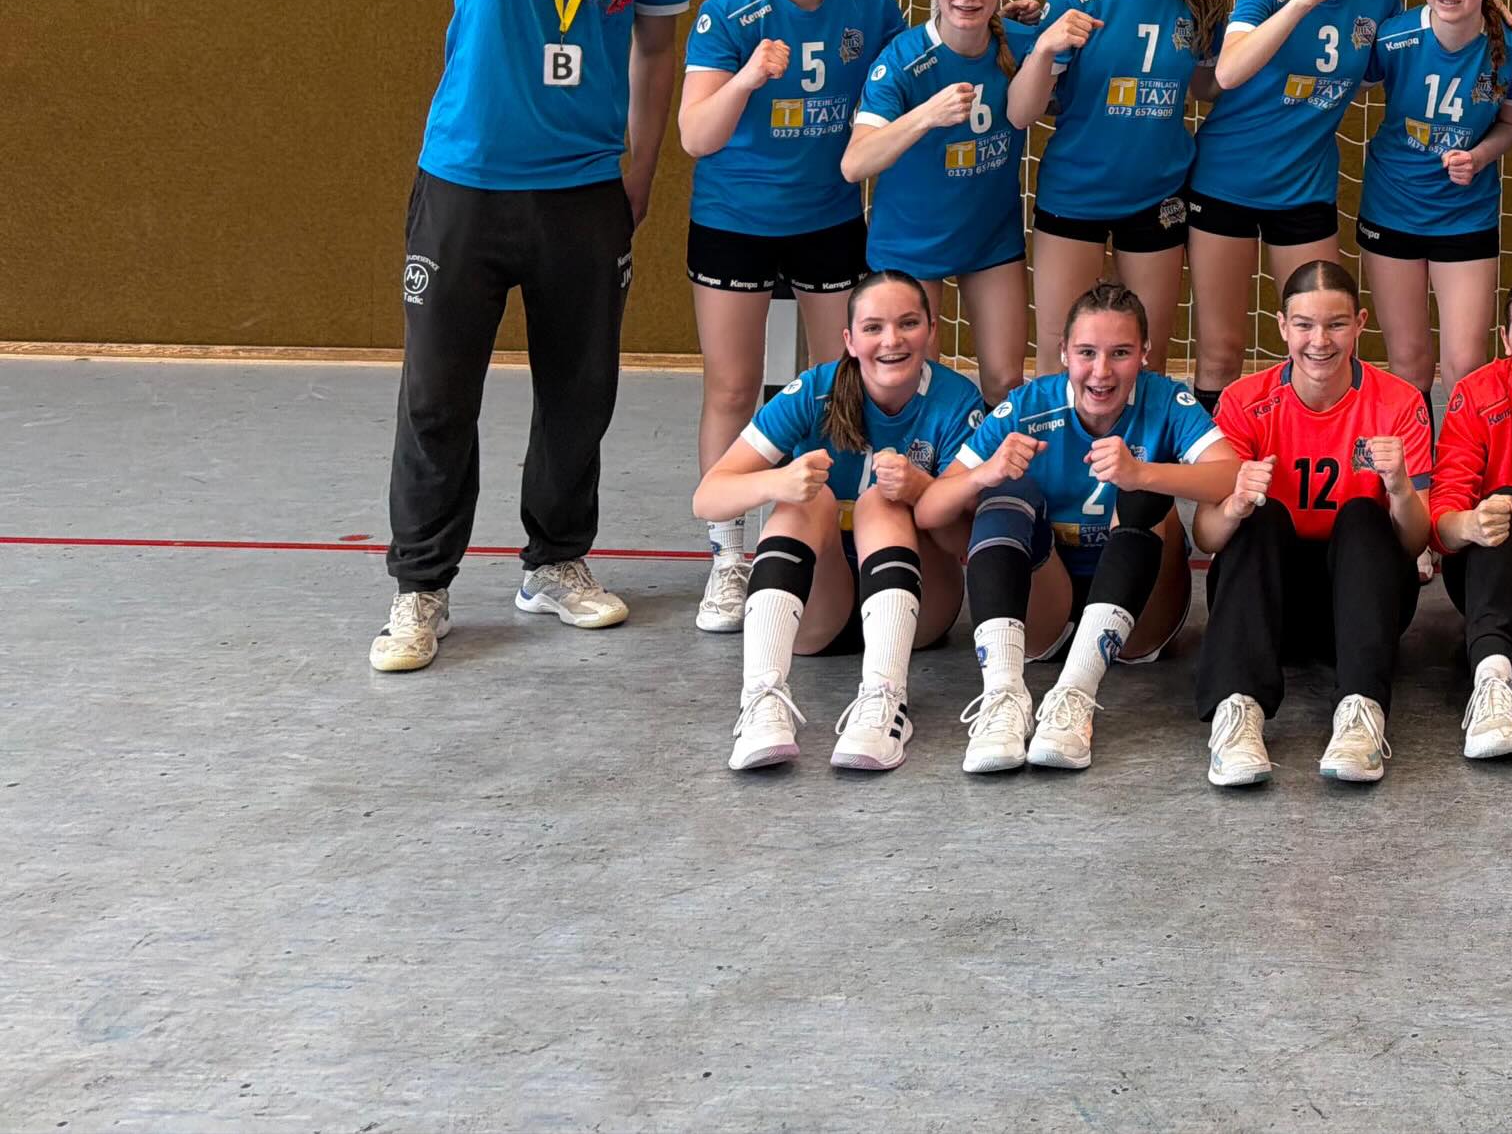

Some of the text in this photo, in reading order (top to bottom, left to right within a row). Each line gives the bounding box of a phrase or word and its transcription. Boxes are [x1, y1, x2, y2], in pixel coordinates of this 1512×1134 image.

[1138, 23, 1160, 73] 7
[1316, 25, 1339, 73] 3
[1385, 37, 1419, 52] Kempa
[552, 53, 573, 80] B
[801, 41, 826, 92] 5
[1140, 80, 1179, 89] STEINLACH
[1139, 88, 1177, 105] TAXI
[1425, 73, 1464, 123] 14
[807, 104, 846, 124] TAXI
[970, 83, 993, 134] 6
[1108, 107, 1173, 117] 0173 6574909
[772, 129, 800, 138] 0173
[1432, 132, 1470, 148] TAXI
[947, 168, 974, 177] 0173
[697, 272, 722, 286] Kempa
[729, 279, 758, 289] Kempa
[822, 280, 851, 290] Kempa
[1028, 418, 1065, 434] Kempa
[1295, 457, 1340, 511] 12
